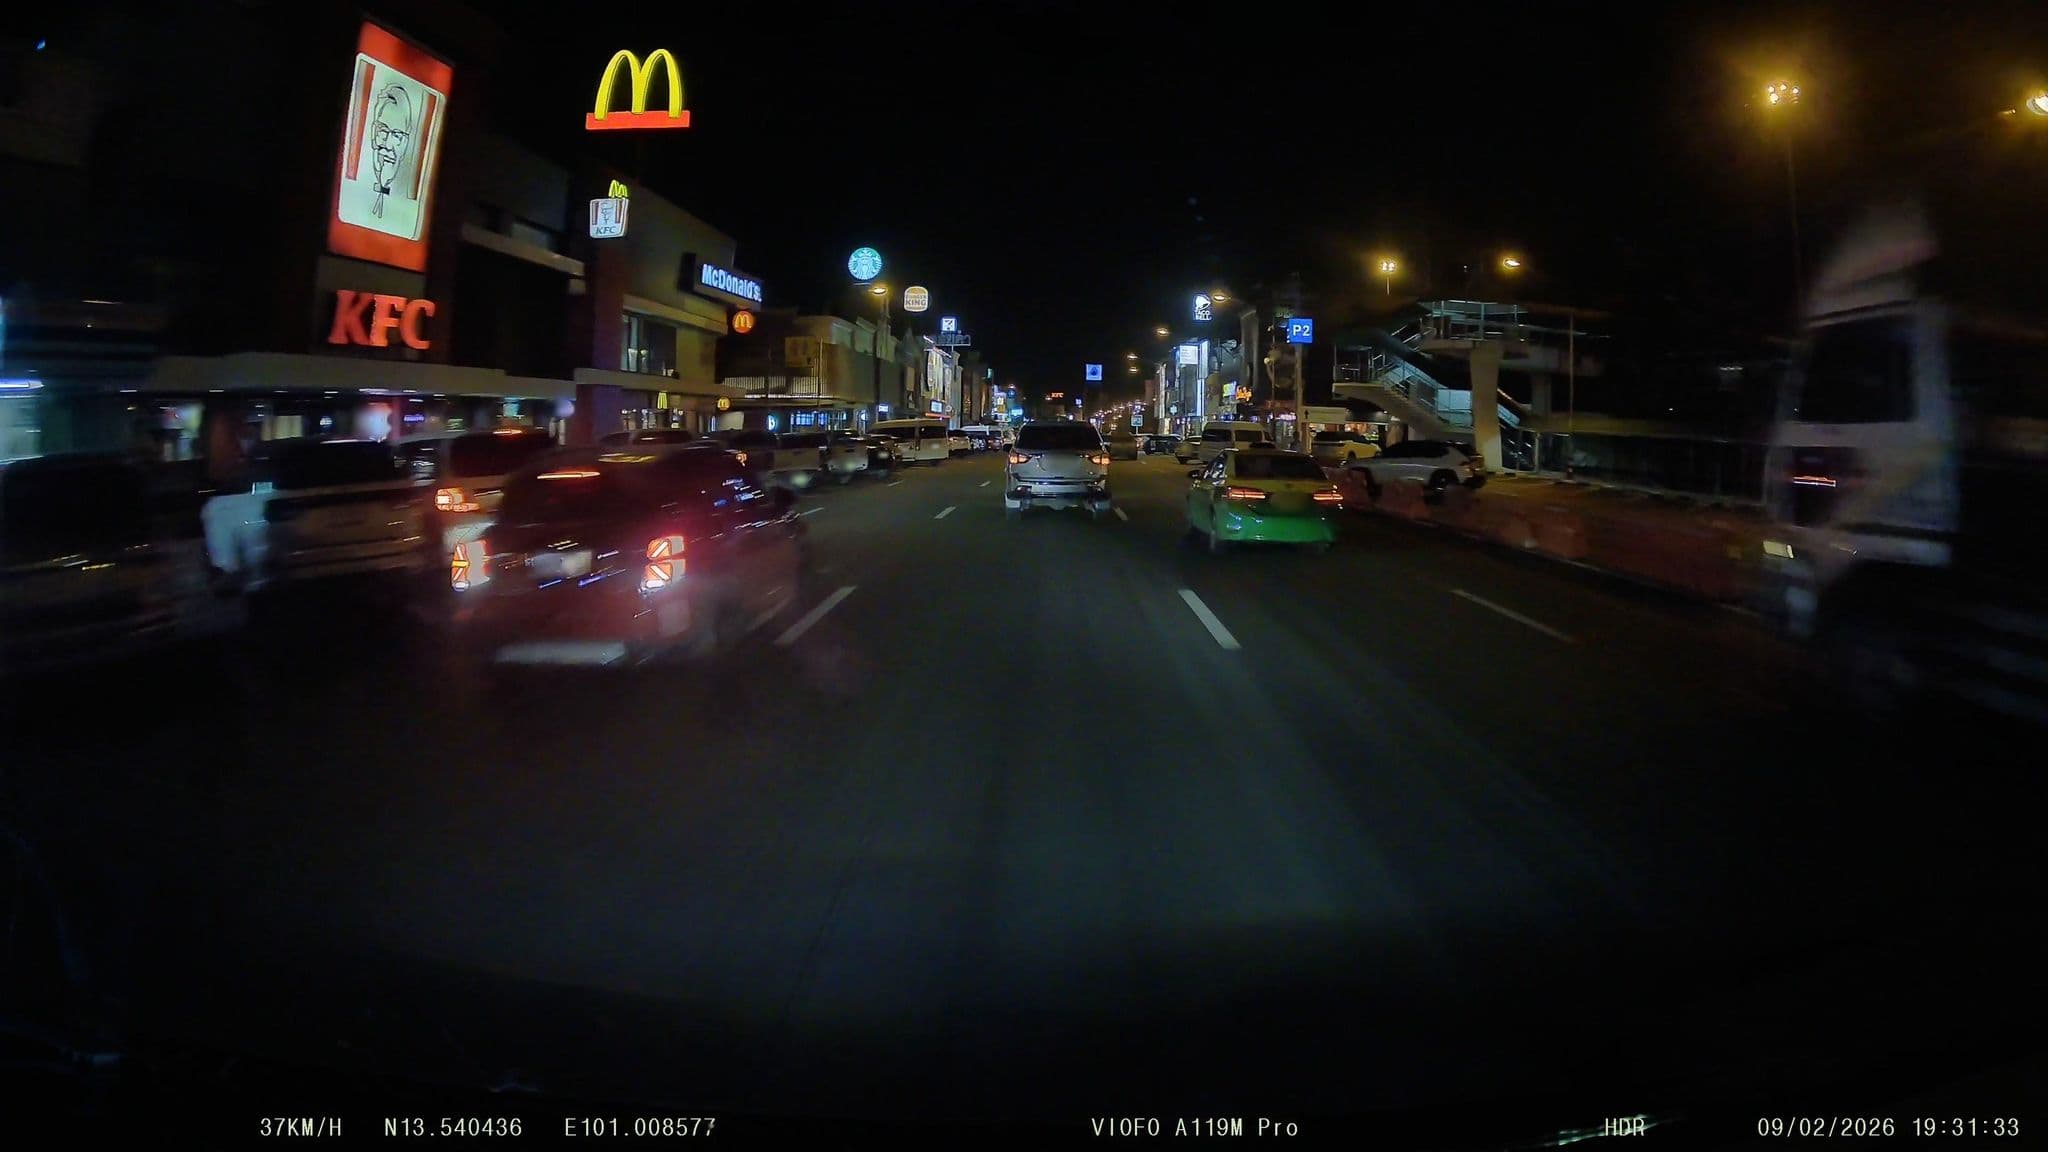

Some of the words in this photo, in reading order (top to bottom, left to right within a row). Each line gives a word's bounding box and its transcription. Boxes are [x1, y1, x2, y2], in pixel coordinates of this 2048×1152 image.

[595, 225, 617, 235] KFC
[702, 264, 764, 302] McDonald's
[328, 290, 435, 349] KFC
